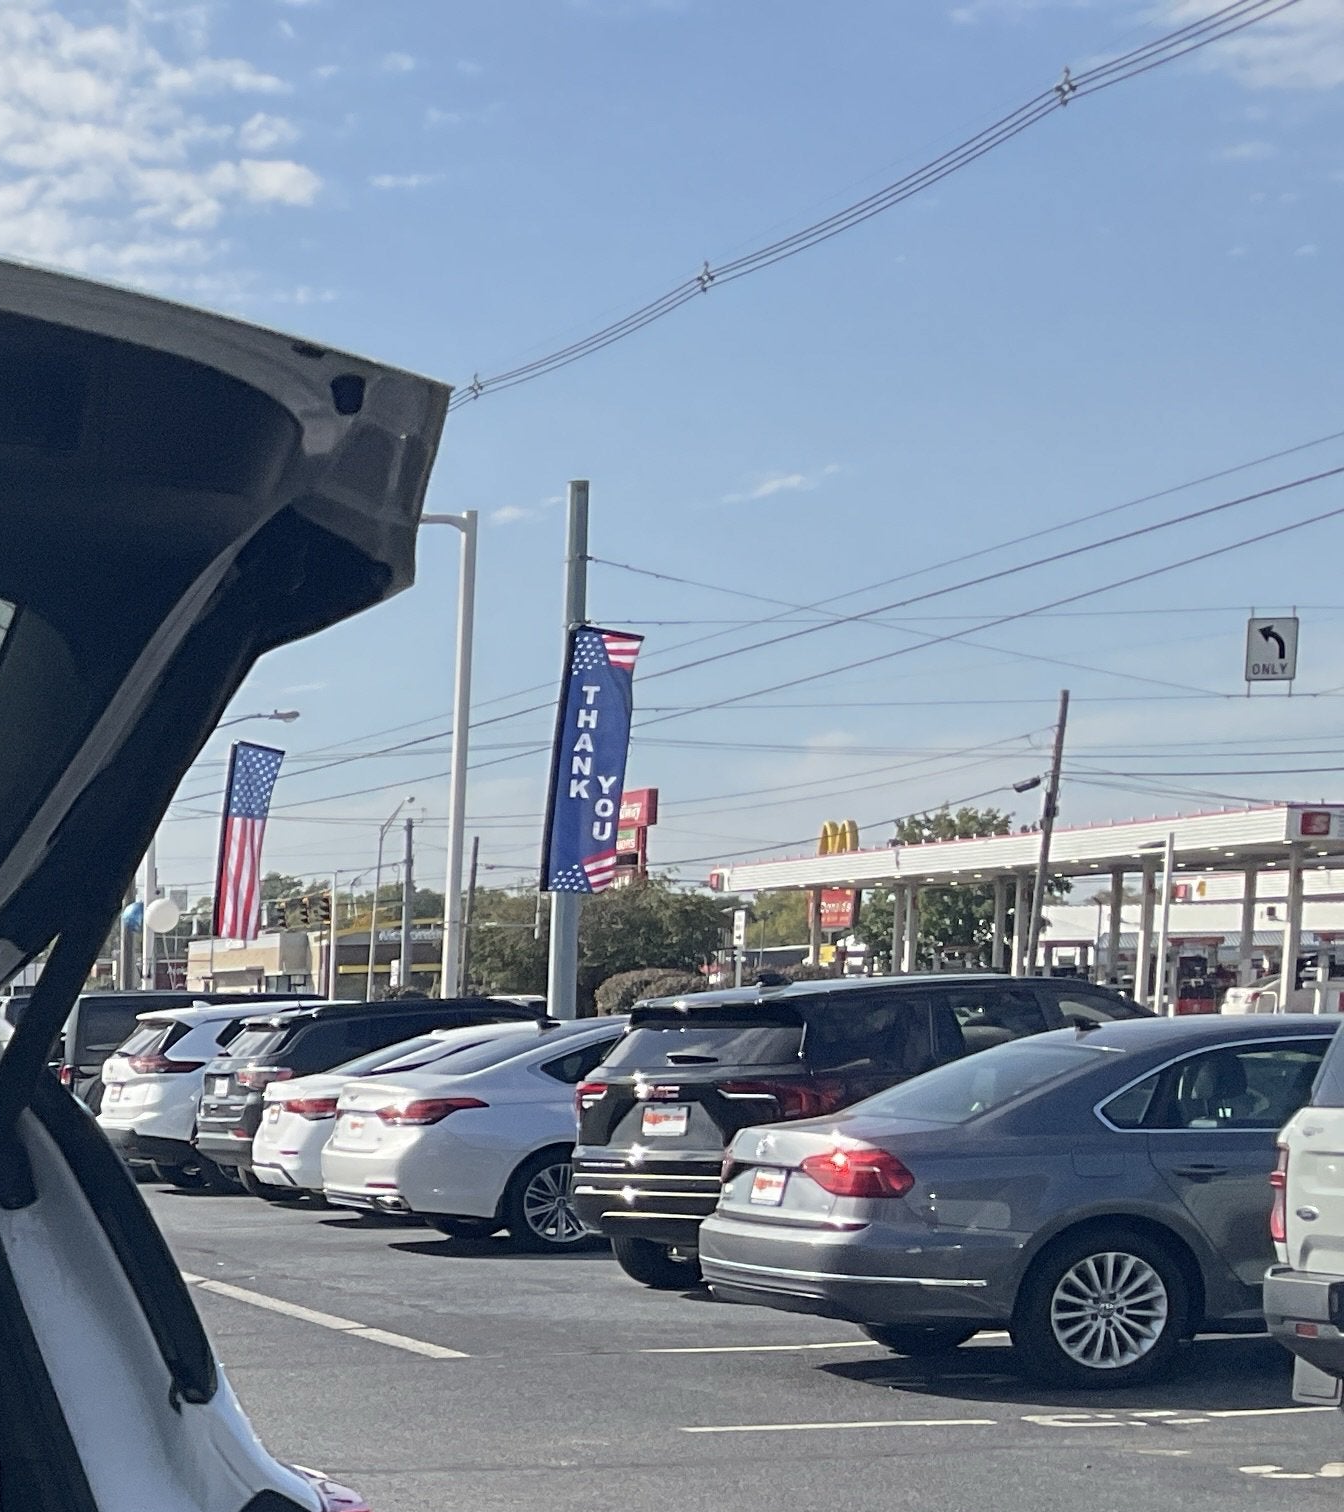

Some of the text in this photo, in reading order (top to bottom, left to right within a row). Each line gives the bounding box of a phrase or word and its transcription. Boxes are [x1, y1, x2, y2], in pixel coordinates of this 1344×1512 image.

[1251, 663, 1288, 676] ONLY
[569, 685, 601, 799] THANK
[592, 775, 617, 841] YOU
